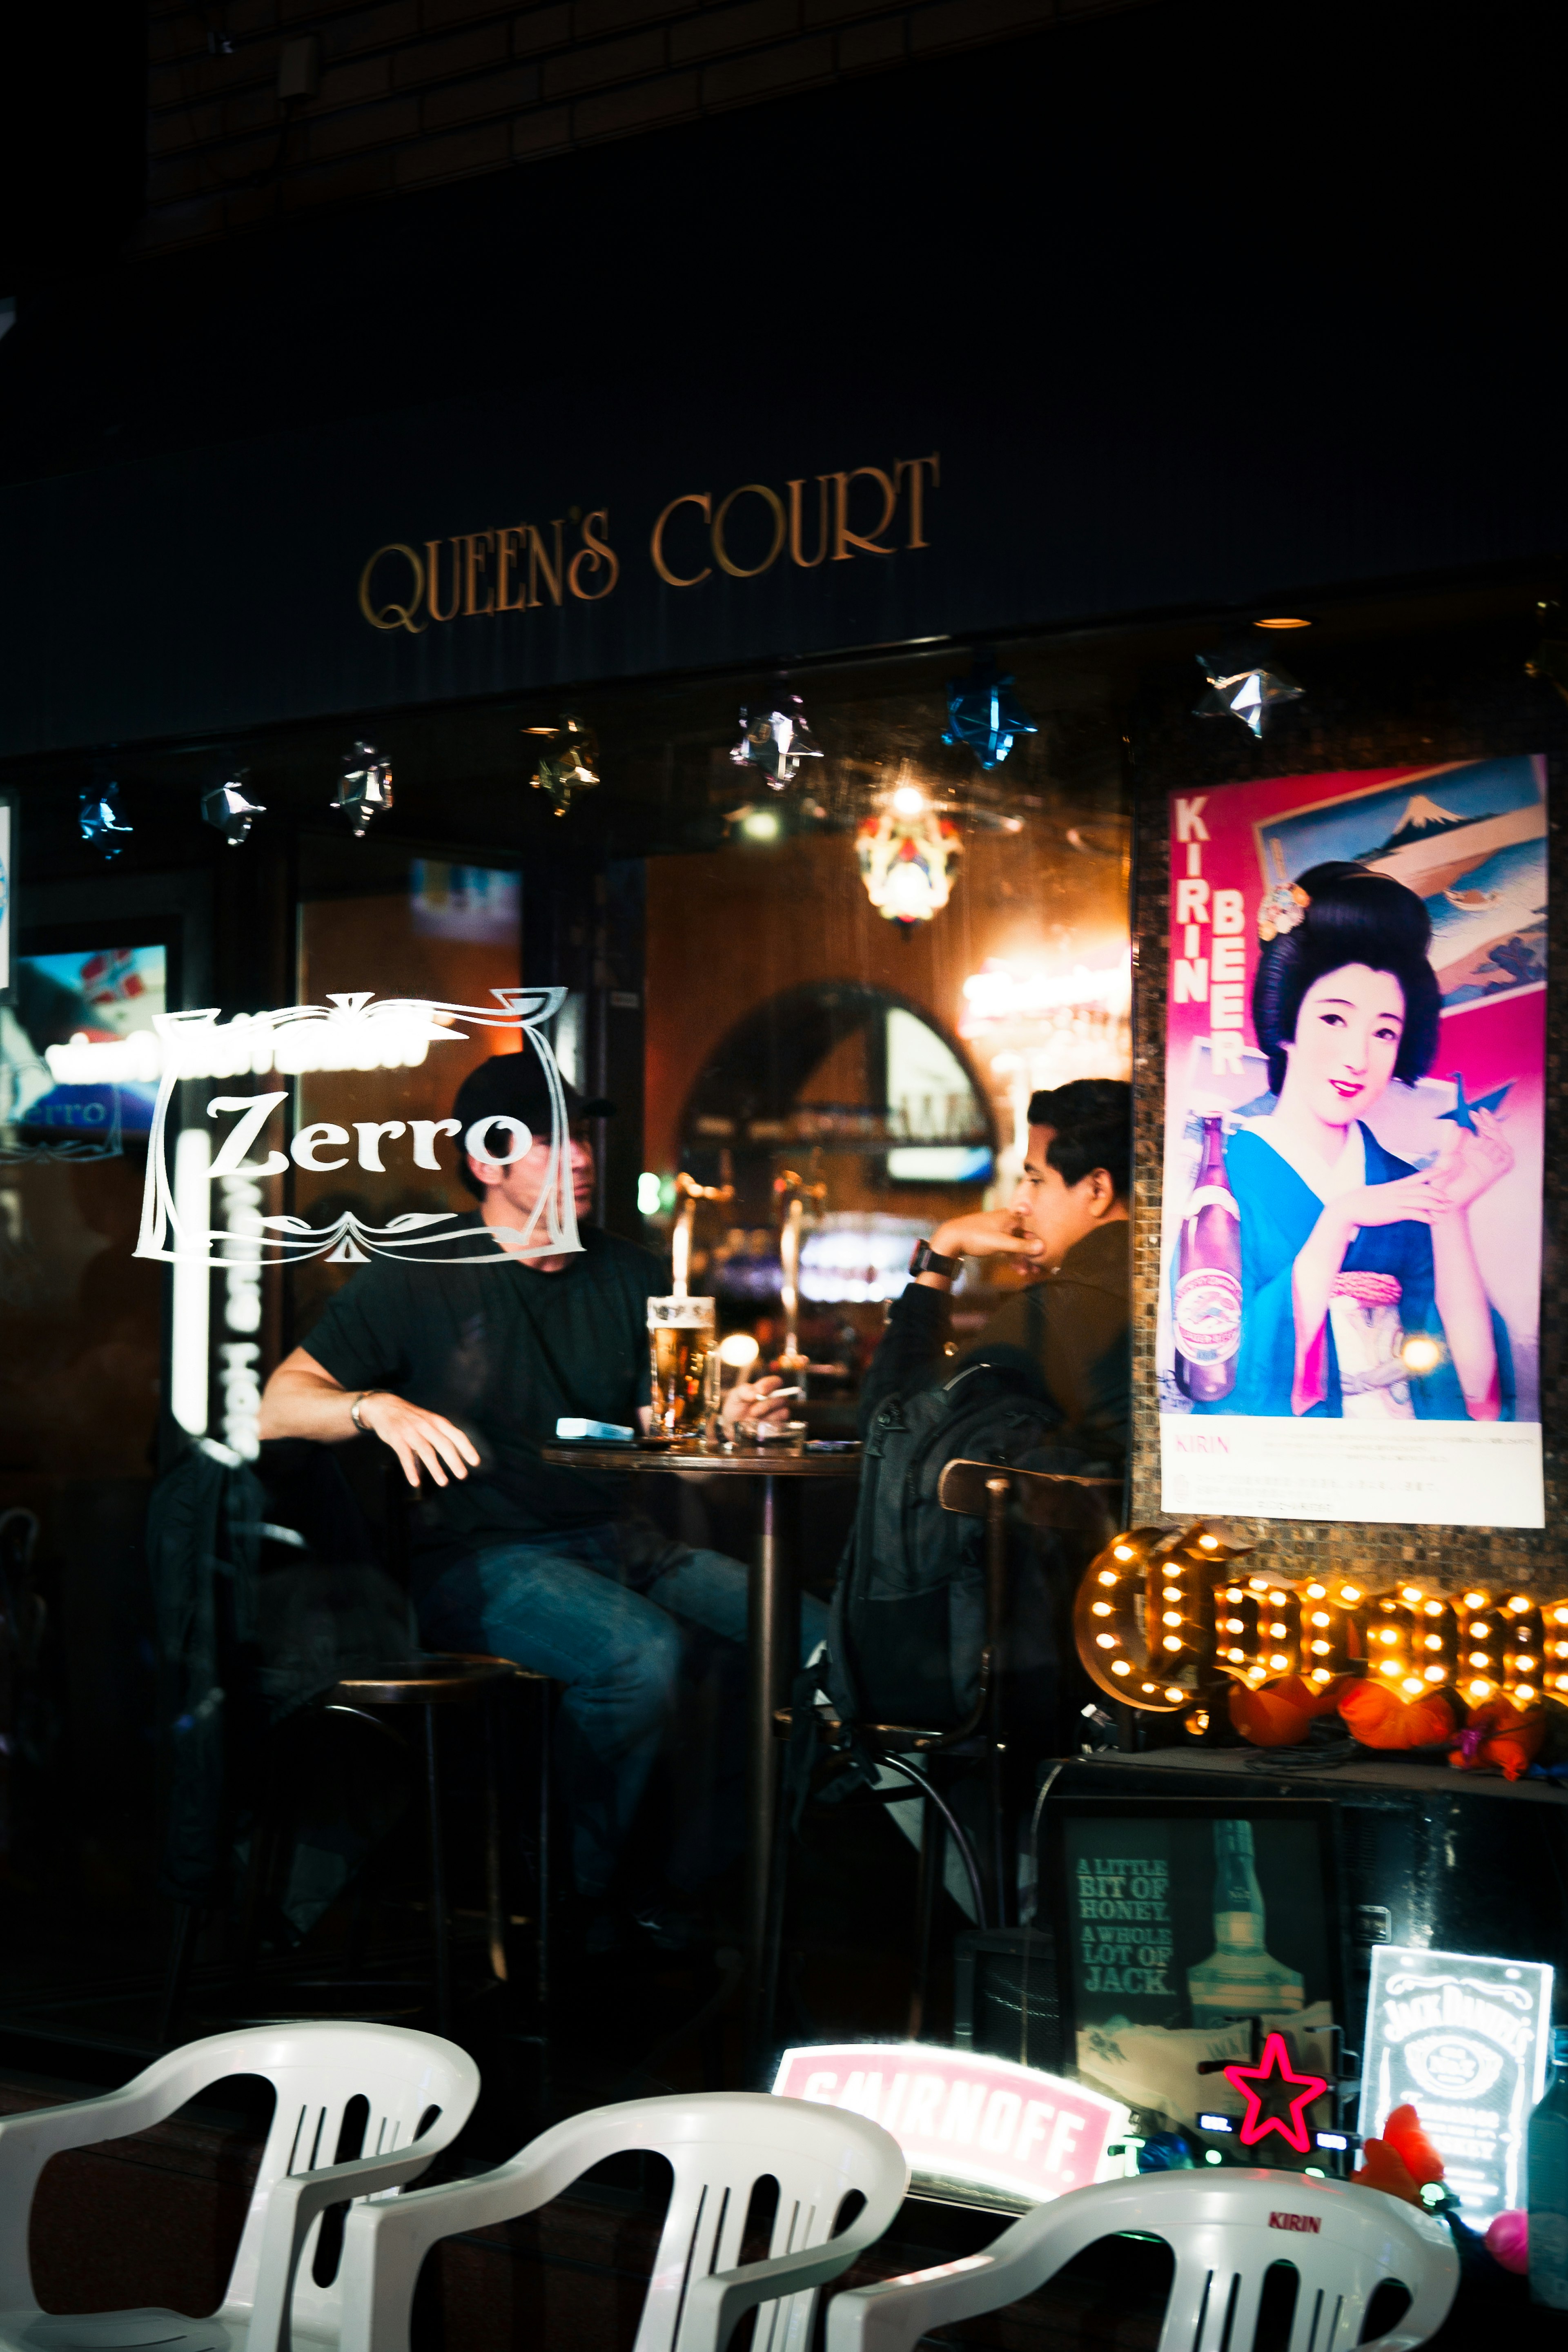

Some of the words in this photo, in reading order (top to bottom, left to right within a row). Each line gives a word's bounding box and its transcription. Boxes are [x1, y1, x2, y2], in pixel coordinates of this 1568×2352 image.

[359, 506, 619, 633] QUEEN'S
[653, 452, 940, 586] COURT
[1174, 795, 1210, 1004] KIRIN
[1209, 889, 1246, 1075] BEER
[202, 1091, 532, 1177] Zerro
[1175, 1434, 1230, 1454] KIRIN
[1076, 1859, 1091, 1874] A
[1093, 1859, 1169, 1876] LITTLE
[1077, 1875, 1127, 1898] BIT
[1130, 1877, 1169, 1900] OF
[1080, 1925, 1097, 1942] A
[1096, 1926, 1173, 1945] WHOLE
[1081, 1943, 1133, 1965] LOT
[1137, 1946, 1174, 1967] OF
[1268, 2211, 1322, 2234] KIRIN
